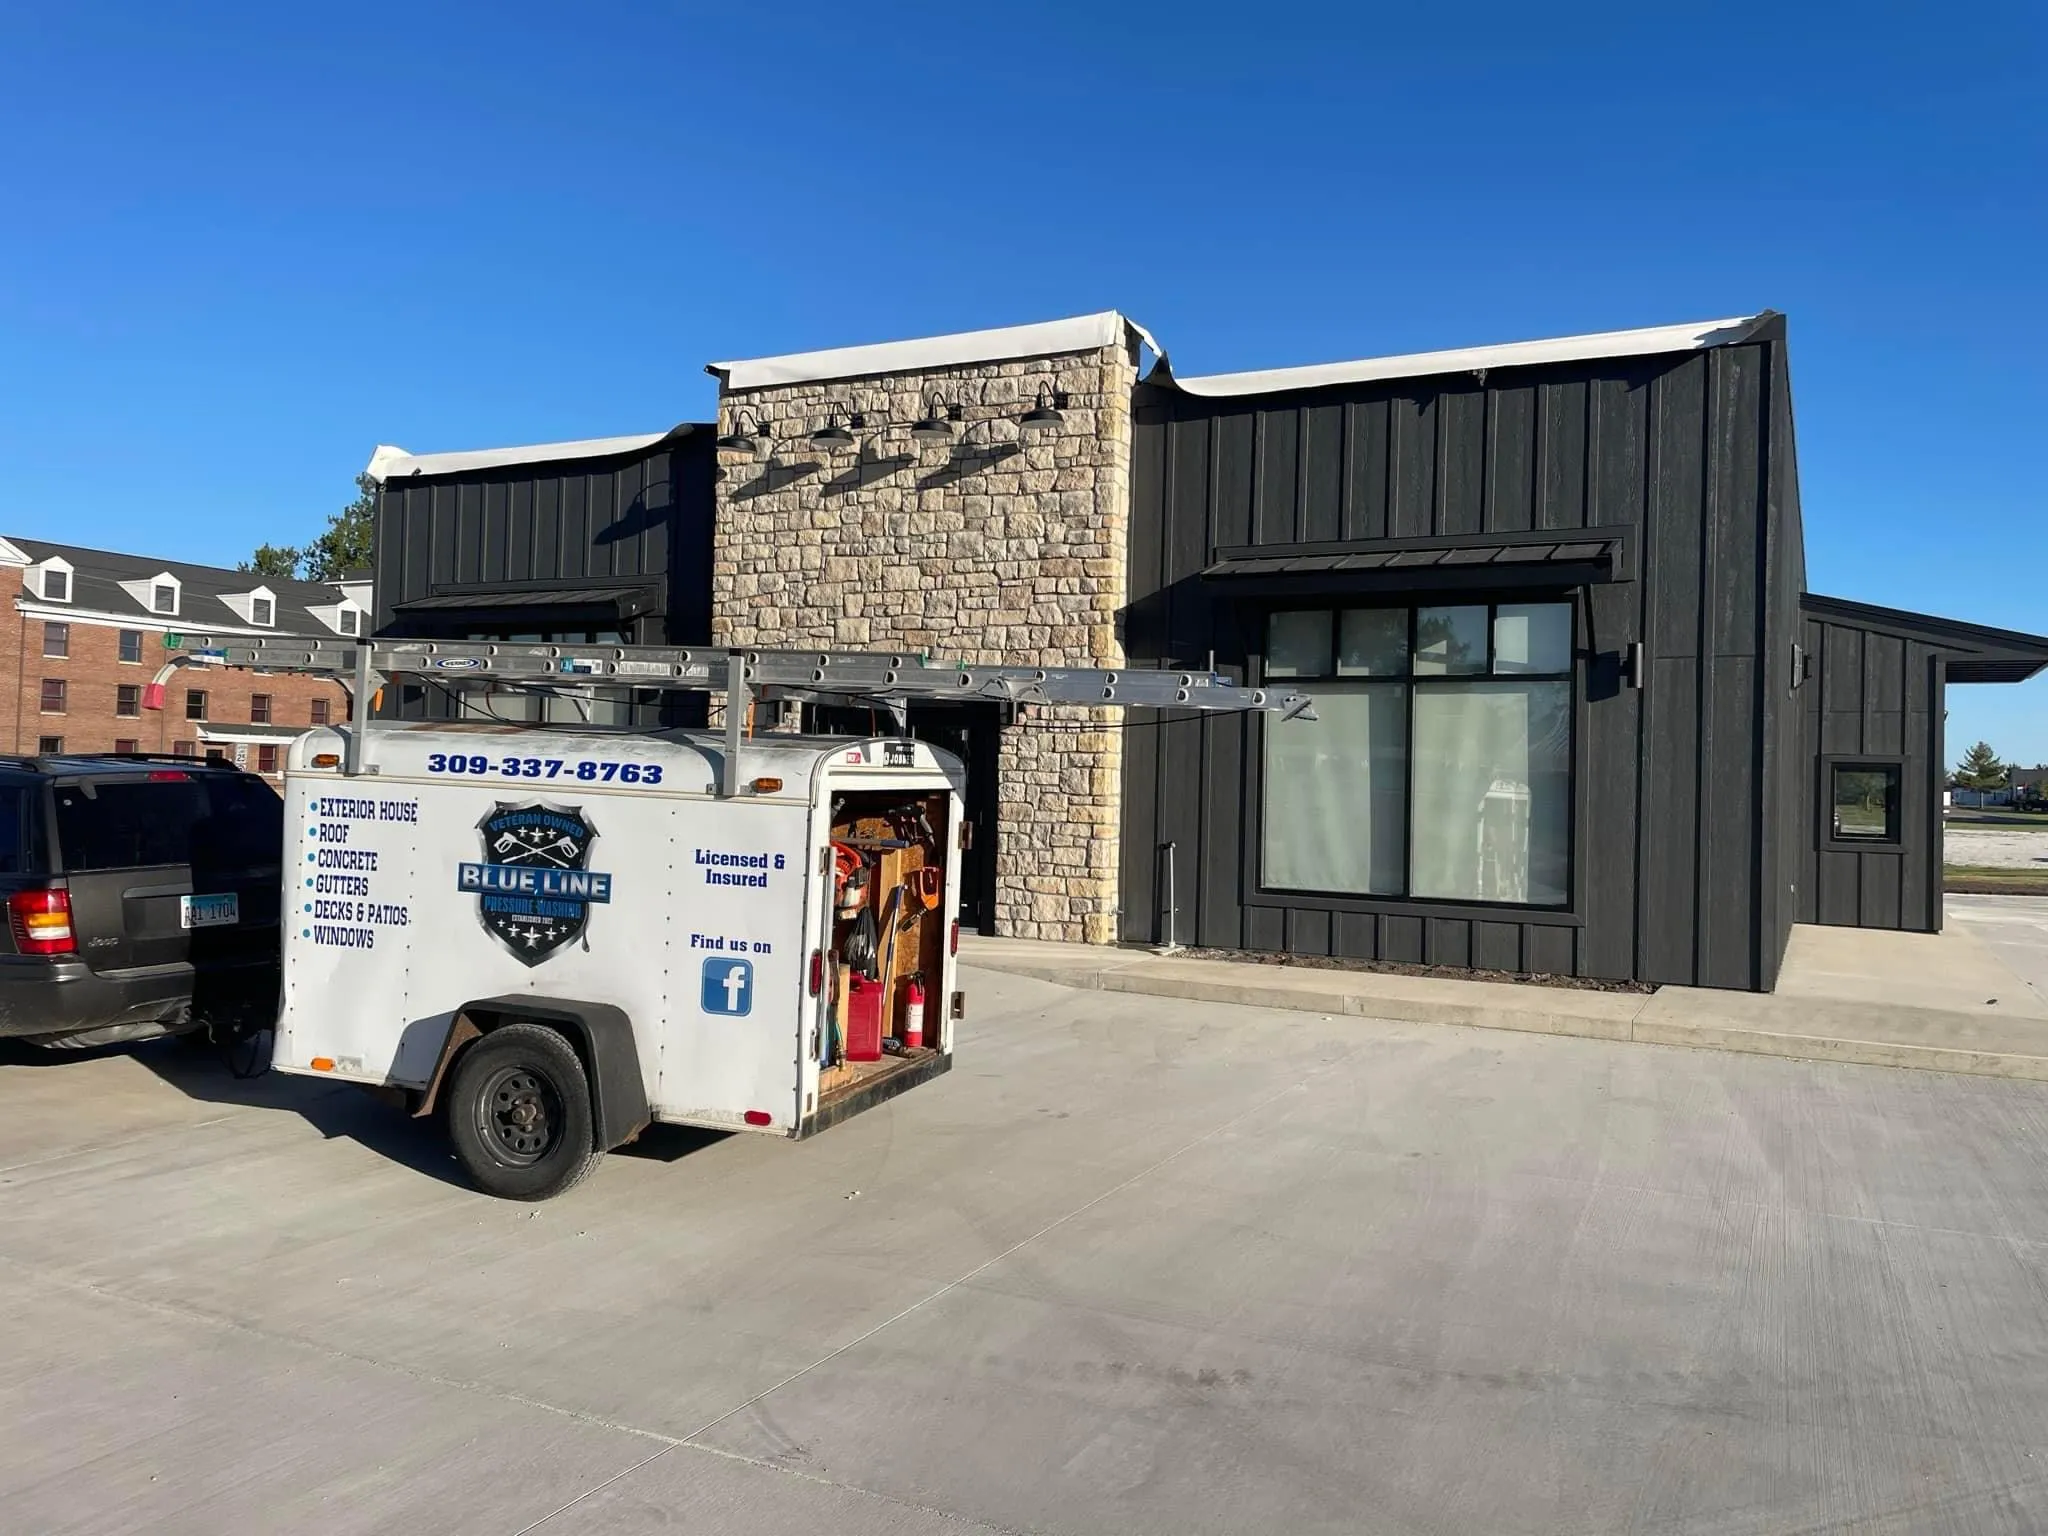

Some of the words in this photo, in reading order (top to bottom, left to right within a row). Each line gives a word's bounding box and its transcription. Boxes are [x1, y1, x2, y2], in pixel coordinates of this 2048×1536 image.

[428, 753, 664, 785] 309-337-8763
[319, 797, 376, 820] EXTERIOR
[379, 800, 418, 822] HOUSE
[319, 822, 350, 843] ROOF
[488, 813, 541, 833] VETERAN
[543, 814, 585, 839] OWNED
[317, 848, 378, 871] CONCRETE
[695, 848, 768, 868] Licensed
[774, 853, 785, 870] &
[316, 873, 369, 896] GUTTERS
[461, 864, 536, 894] BLUE
[543, 870, 608, 897] LINE
[706, 868, 768, 888] Insured
[314, 898, 353, 921] DECKS
[356, 902, 365, 922] &
[367, 903, 408, 926] PATIOS
[484, 895, 534, 915] PRESSURE
[535, 899, 582, 920] WASHING
[313, 925, 374, 949] WINDOWS
[690, 933, 724, 950] Find
[730, 939, 748, 952] us
[753, 941, 772, 954] on
